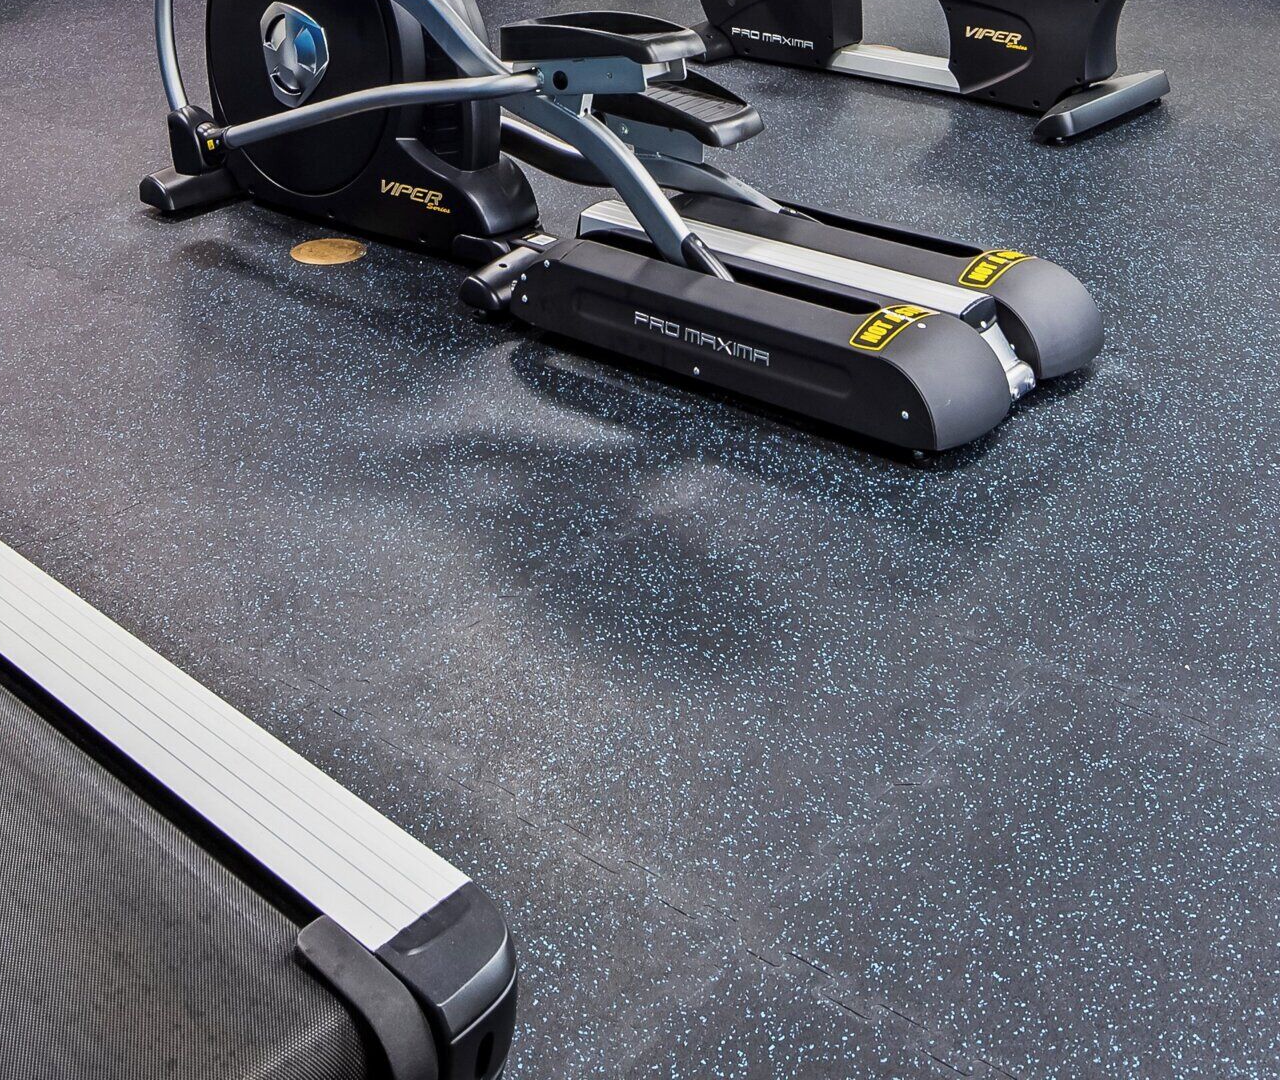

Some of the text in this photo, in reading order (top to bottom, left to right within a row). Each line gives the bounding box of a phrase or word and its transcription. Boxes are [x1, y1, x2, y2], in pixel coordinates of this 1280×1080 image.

[731, 26, 814, 50] PRO MAXIMA
[965, 25, 1022, 44] VIPER
[380, 179, 443, 206] VIPER
[967, 261, 998, 282] NOT
[634, 311, 770, 367] PRO MAXIMA
[860, 319, 894, 344] NOT
